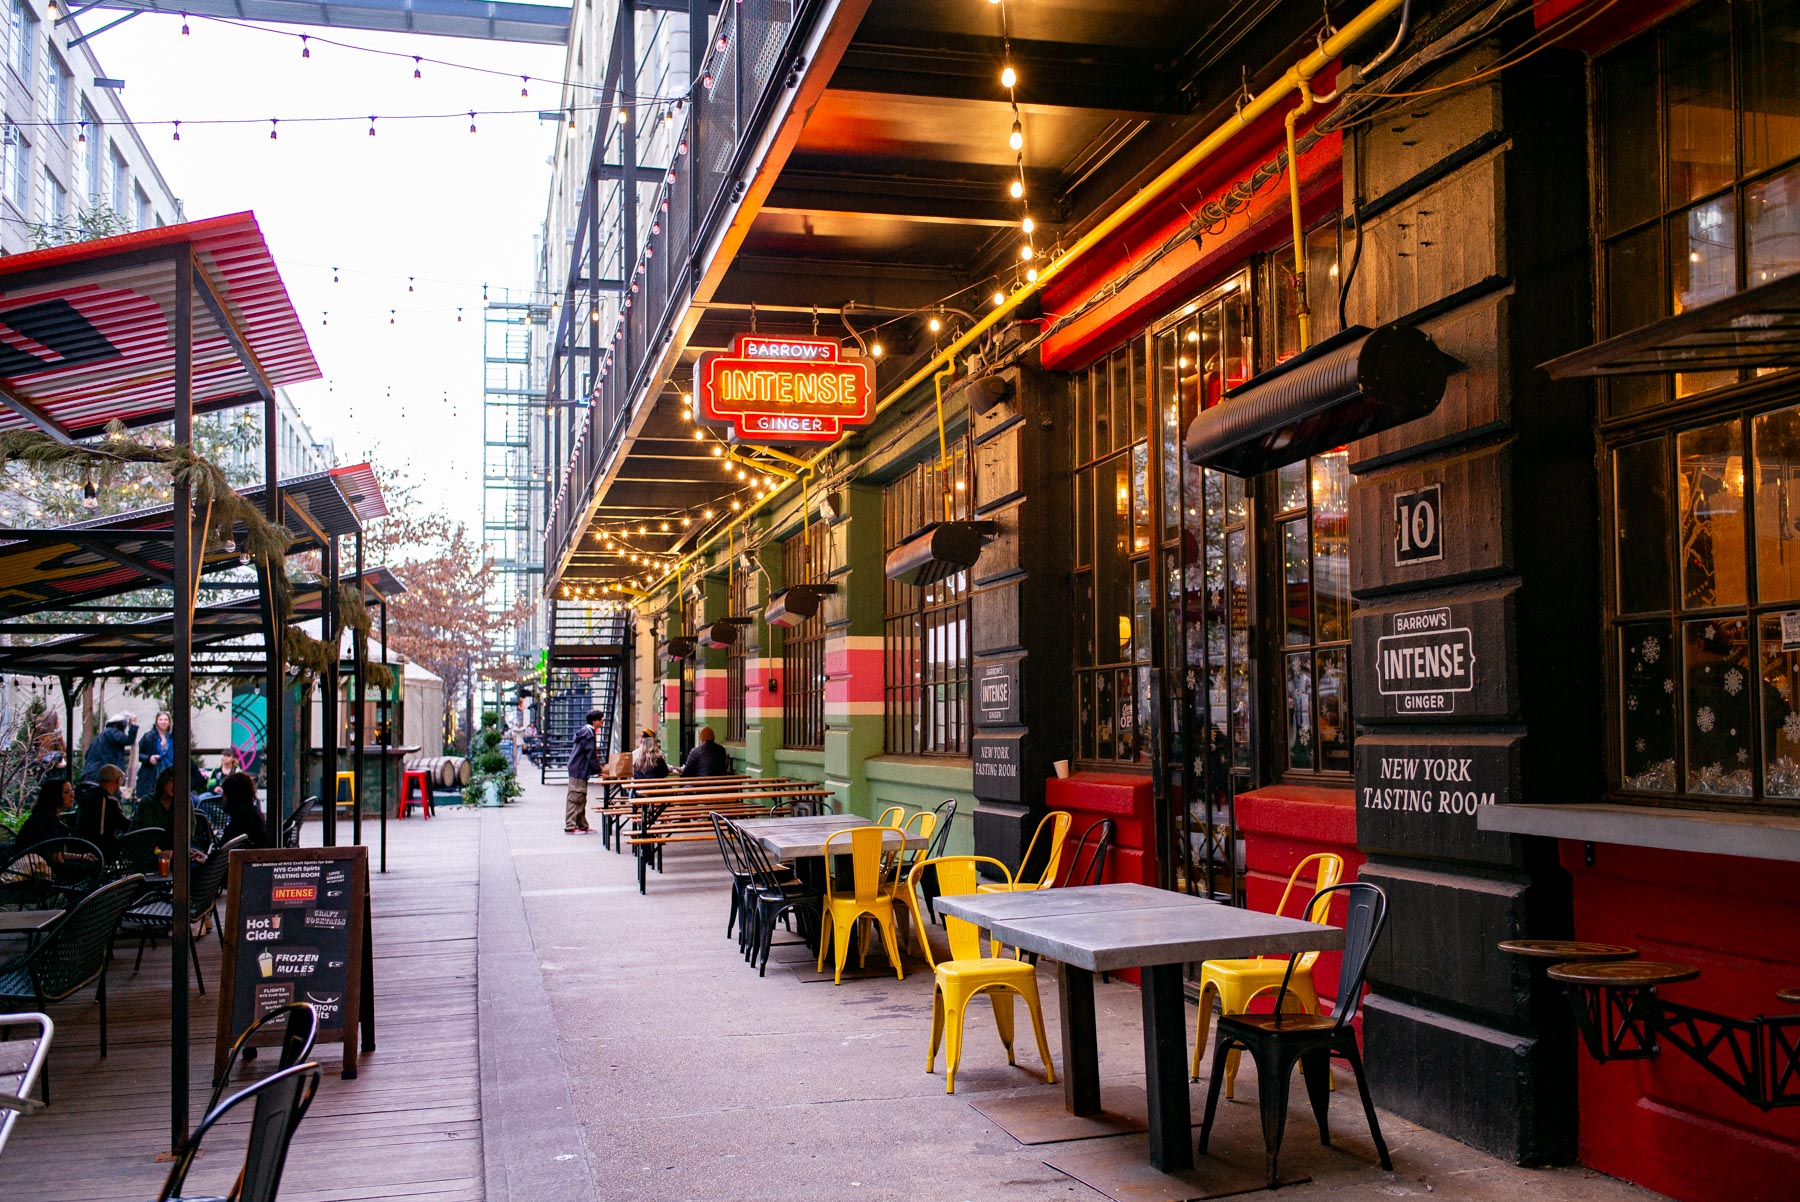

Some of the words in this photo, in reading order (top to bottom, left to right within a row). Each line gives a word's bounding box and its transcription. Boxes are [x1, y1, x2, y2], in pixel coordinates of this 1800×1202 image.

[748, 344, 830, 358] BARROW'S
[722, 370, 856, 403] INTENSE
[758, 417, 822, 431] GINGER
[1400, 501, 1435, 552] 10
[1397, 613, 1447, 631] BARROW'S
[1384, 643, 1464, 680] INTENSE
[982, 684, 1008, 702] INTENSE
[1404, 695, 1445, 709] GINGER
[981, 746, 993, 759] NEW
[994, 746, 1010, 759] YORK
[976, 762, 998, 776] TASTING
[998, 764, 1016, 776] ROOM
[1380, 758, 1420, 781] NEW
[1423, 759, 1473, 782] YORK
[1363, 787, 1433, 813] TASTING
[275, 888, 314, 898] INTENSE
[314, 910, 339, 918] CRAFT
[246, 918, 270, 930] Hot
[305, 917, 347, 926] COCKTAILS
[246, 930, 280, 941] Cider
[275, 953, 320, 962] FROZEN
[276, 965, 315, 974] MULES
